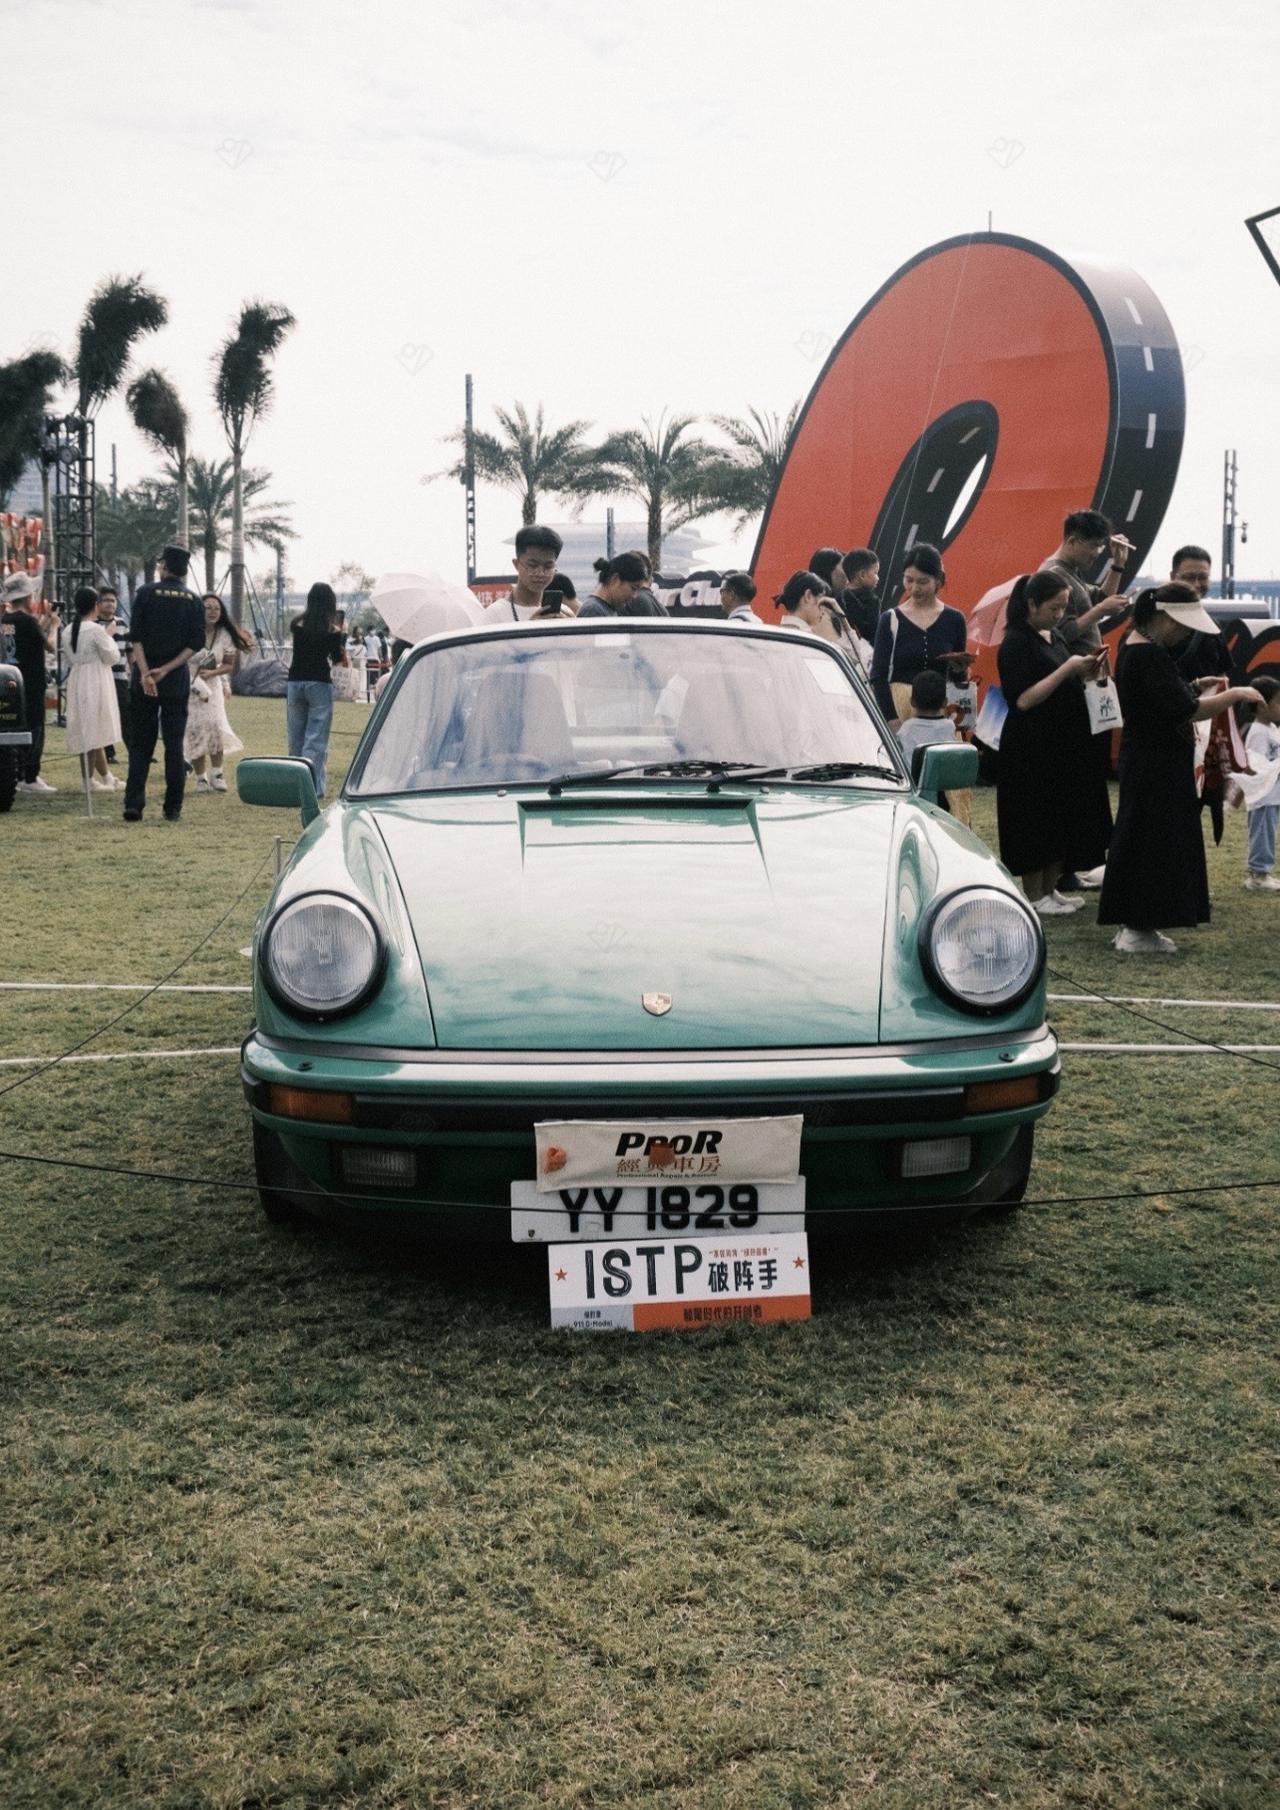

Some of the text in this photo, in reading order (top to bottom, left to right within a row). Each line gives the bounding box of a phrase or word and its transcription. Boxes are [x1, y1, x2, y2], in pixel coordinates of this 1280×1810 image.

[560, 1185, 759, 1233] YY 1829
[585, 1244, 703, 1299] ISTP
[708, 1259, 778, 1292] 破阵手
